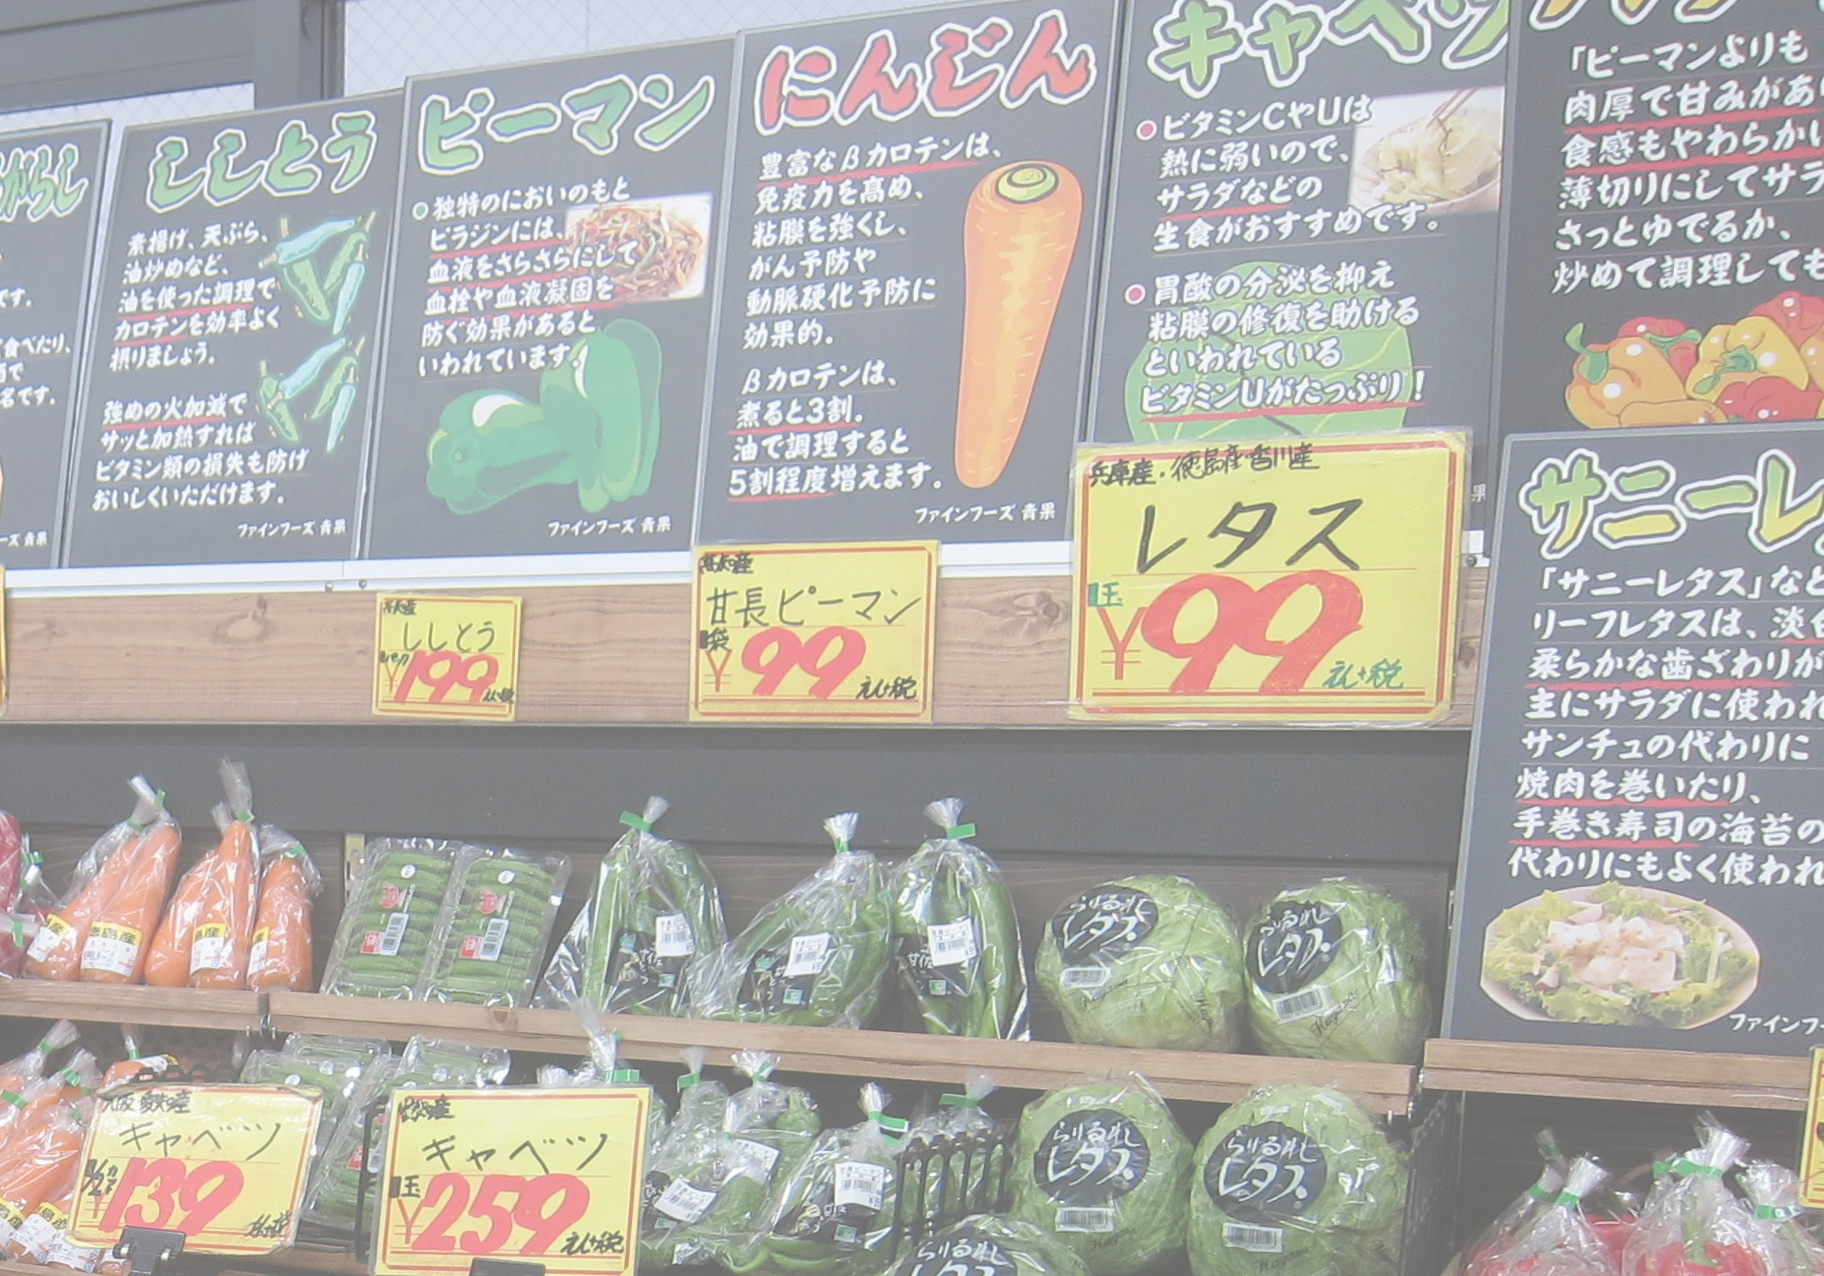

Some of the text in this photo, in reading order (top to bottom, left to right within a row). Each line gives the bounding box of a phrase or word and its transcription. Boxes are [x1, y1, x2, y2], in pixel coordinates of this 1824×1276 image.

[754, 9, 1097, 136] にんじん
[1570, 29, 1810, 80] 「ピーマンよりも
[1163, 93, 1375, 141] ビタミンCやUは
[1562, 73, 1824, 126] 肉厚で甘みがあ
[417, 72, 716, 176] ピーマン
[146, 110, 377, 214] ししとう
[760, 131, 1003, 182] 豊富なβカロテンは、
[1158, 135, 1351, 180] 熱に弱いので、
[434, 174, 631, 221] 独特のにおいのもと
[755, 174, 925, 215] 免疫力を高め、
[1157, 174, 1324, 213] サラダなどの
[1558, 160, 1824, 211] 薄切りにしてサラ
[128, 219, 269, 257] 素揚げ、天ぷら、
[430, 216, 565, 251] ピラジンには、
[752, 210, 909, 248] 粘膜を強くし、
[1153, 201, 1441, 253] 生食がおすすめです。
[1554, 206, 1792, 252] さっとゆでるか、
[123, 254, 229, 285] 油炒めなど、
[427, 240, 639, 285] 血液をさらさらにして
[749, 246, 877, 282] がん予防や
[1551, 248, 1824, 296] 炒めて調理しても
[119, 277, 276, 314] 油を使った調理で
[424, 275, 614, 316] 血栓や血液凝固を
[746, 275, 937, 318] 動脈硬化予防に
[1154, 259, 1395, 307] 胃酸の分泌を抑え
[114, 306, 280, 342] カロテンを効率よく
[422, 311, 597, 347] 防ぐ効果があると
[744, 318, 834, 350] 効果的。
[1149, 296, 1420, 343] 粘膜の修復を助ける
[110, 340, 216, 371] 摂りましょう。
[418, 343, 584, 377] いわれています。
[1145, 337, 1343, 378] といわれている
[741, 356, 900, 396] βカロテンは、
[103, 392, 248, 426] 強めの火加減で
[736, 394, 864, 430] 煮ると3割。
[101, 420, 254, 453] サッと加熱すれば
[732, 427, 910, 463] 油で調理すると
[96, 446, 308, 483] ビタミン類の損失も防げ
[729, 461, 944, 499] 5割程度増えます。
[92, 480, 285, 511] おいしくいただけます。
[914, 500, 1056, 525] ファインフーズ 青果
[237, 518, 346, 538] ファインフーズ 青果
[547, 515, 672, 537] ファインフーズ 青果
[1137, 498, 1363, 575] レタス
[706, 585, 922, 627] 甘長ピーマン
[403, 620, 495, 653] ししとう
[1527, 646, 1824, 682] 柔らかな歯ざわりが
[1523, 686, 1824, 723] 主にサラダに使われ
[1520, 727, 1810, 764] サンチュの代わりに
[1515, 767, 1761, 803] 焼肉を巻いたり、
[1512, 807, 1824, 847] 手巻き寿司の海苔の
[1507, 846, 1824, 887] 代わりにもよく使われ
[119, 1122, 282, 1158] キャベツ
[422, 1131, 609, 1175] キャベツ
[1048, 1145, 1135, 1186] レタス
[1218, 1157, 1308, 1202] レタス
